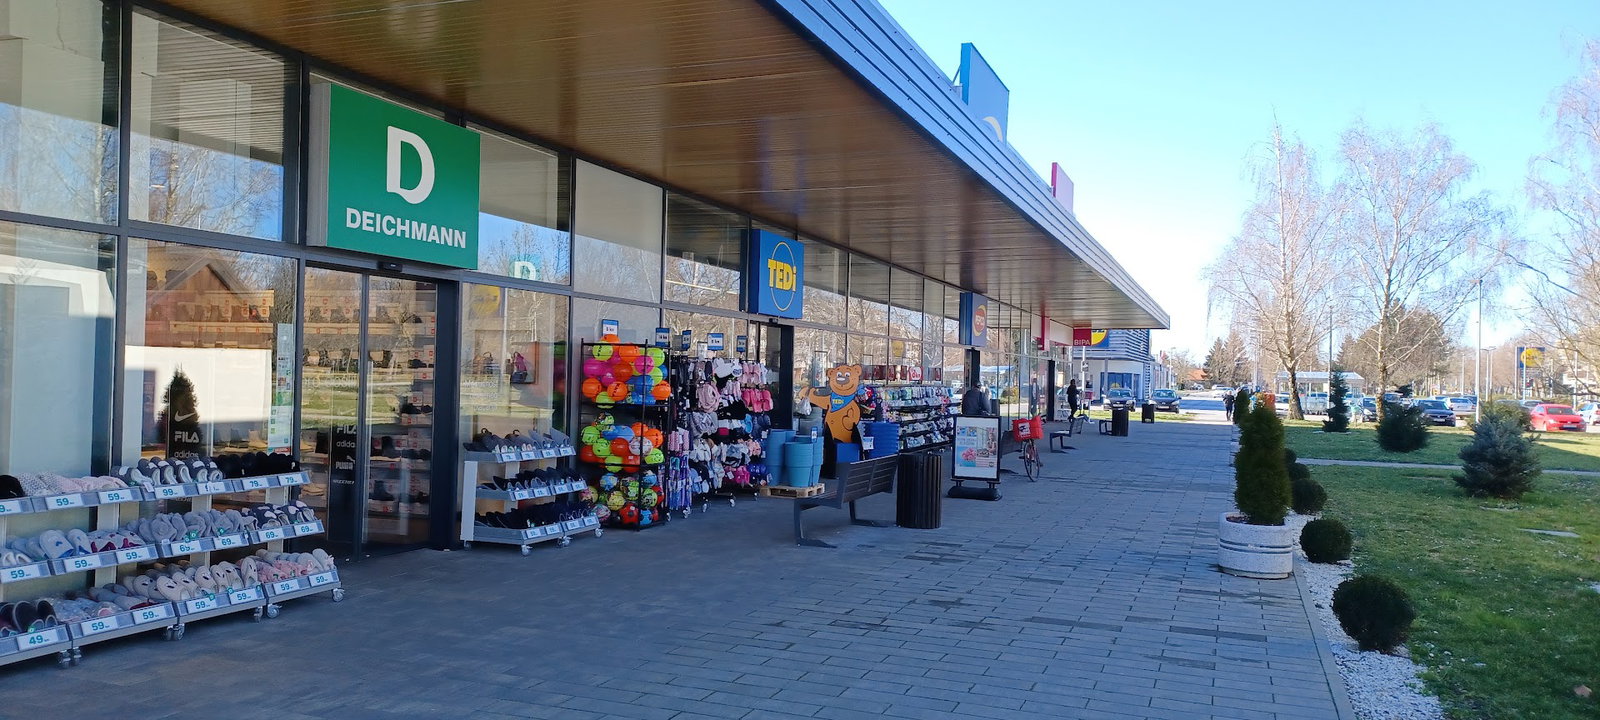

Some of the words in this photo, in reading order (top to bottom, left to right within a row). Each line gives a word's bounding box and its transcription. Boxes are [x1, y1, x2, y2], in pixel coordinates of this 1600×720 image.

[387, 125, 435, 204] D
[346, 207, 467, 248] DEICHMANN
[767, 258, 797, 292] TEDi
[174, 431, 199, 443] FILA
[174, 450, 199, 460] adidas
[163, 488, 174, 496] 99
[108, 493, 120, 501] 59
[56, 498, 69, 506] 59
[126, 552, 138, 560] 59
[75, 560, 88, 568] 59
[11, 570, 25, 578] 59
[143, 611, 154, 619] 59
[92, 622, 104, 630] 59
[29, 635, 43, 644] 49
